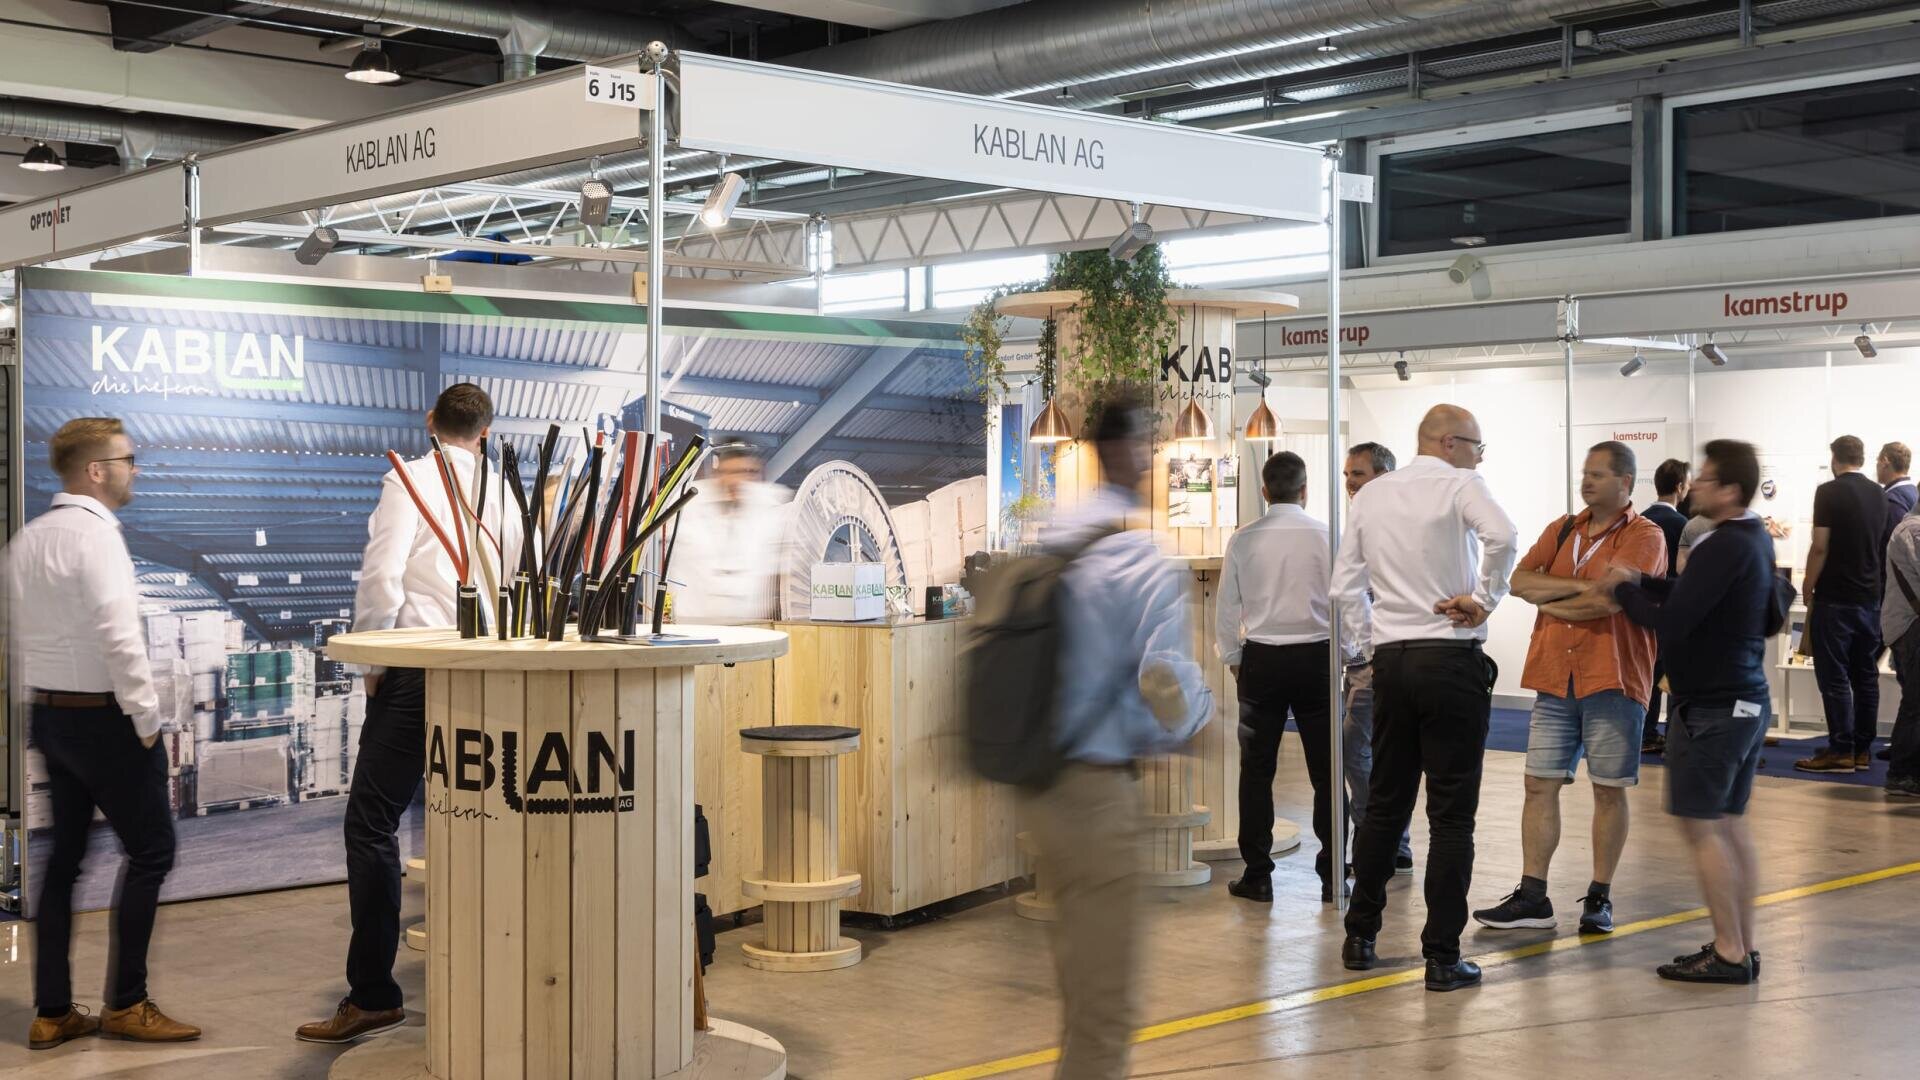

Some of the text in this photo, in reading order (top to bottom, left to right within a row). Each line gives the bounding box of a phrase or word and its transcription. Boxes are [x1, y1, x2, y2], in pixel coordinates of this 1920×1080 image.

[589, 79, 635, 101] 6 J15
[346, 127, 436, 174] KABLAN AG
[974, 123, 1104, 170] KABLAN AG
[30, 205, 72, 231] OPTONET
[1724, 291, 1848, 317] kamstrup
[1282, 326, 1370, 346] kamsrup
[92, 325, 304, 391] KABLAN
[92, 374, 130, 395] die
[1613, 431, 1658, 442] kamstrup
[812, 583, 853, 598] KABLAN
[856, 583, 884, 597] KABLAN
[425, 722, 635, 814] ABLAN
[619, 799, 633, 809] AG
